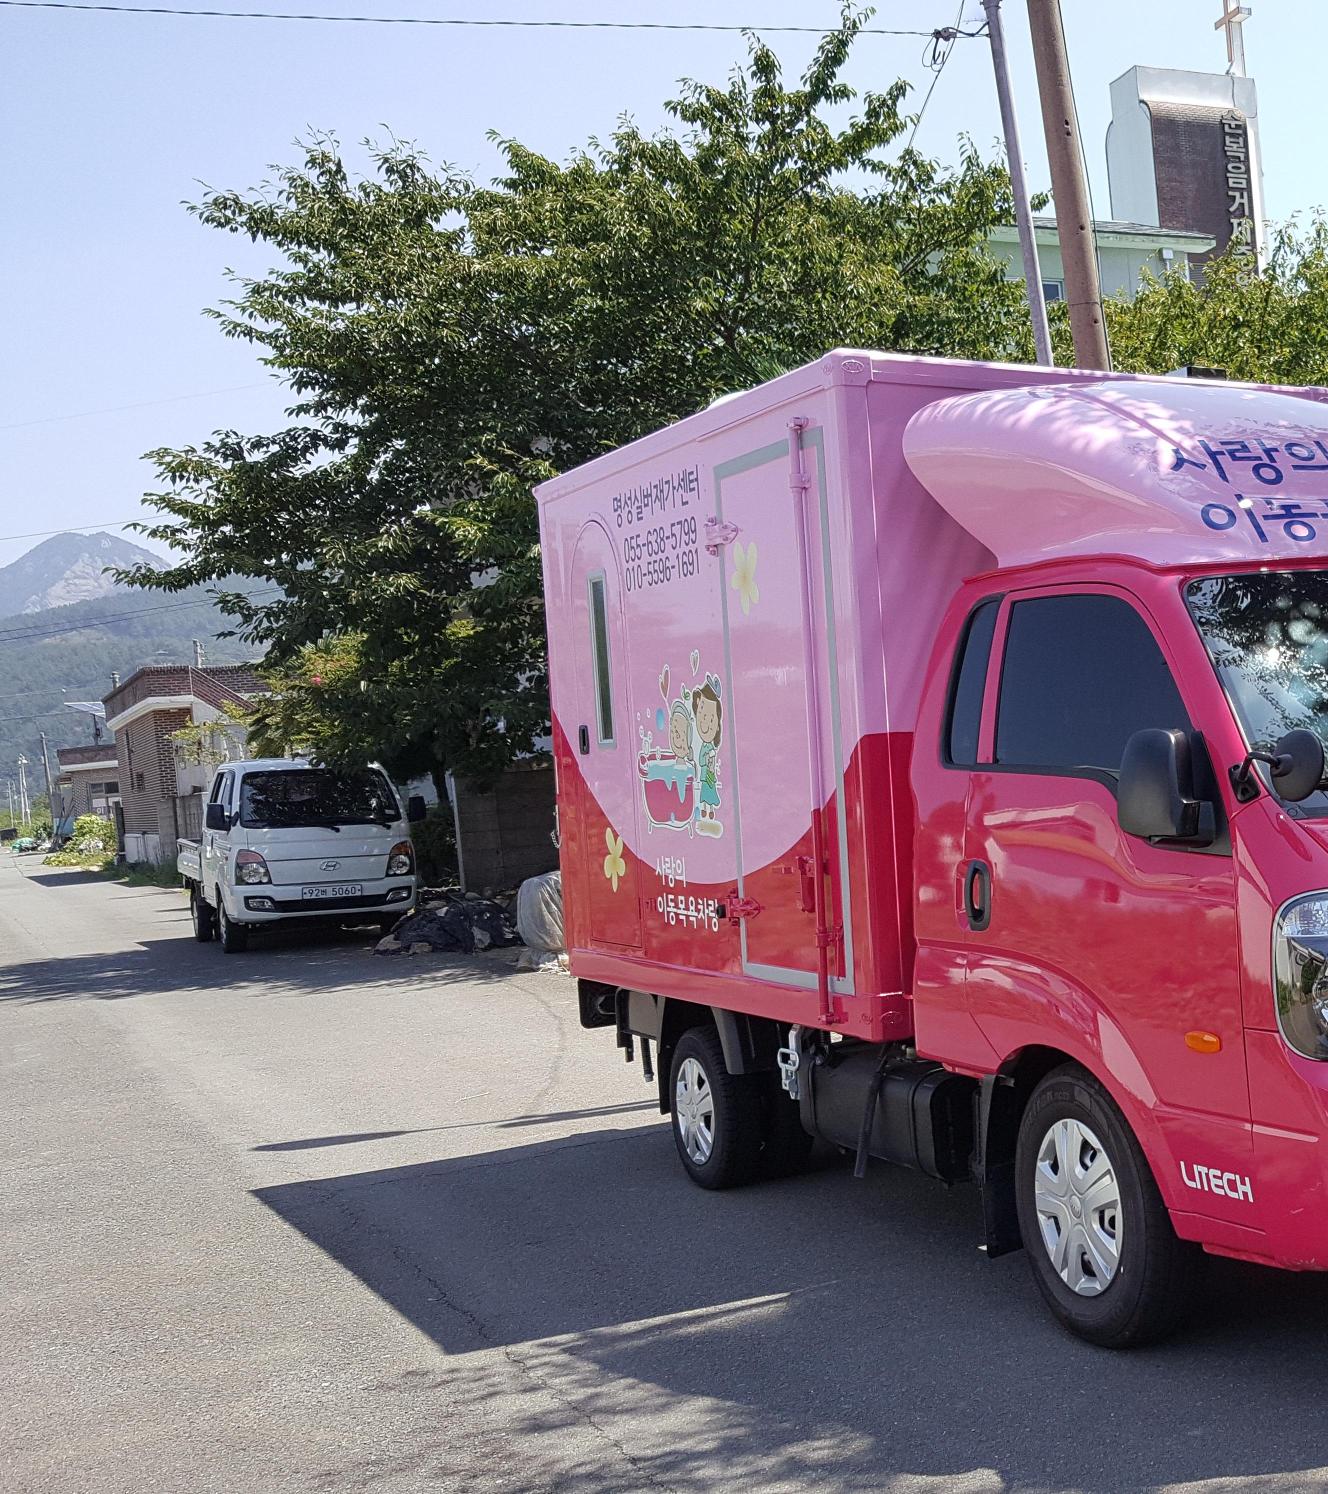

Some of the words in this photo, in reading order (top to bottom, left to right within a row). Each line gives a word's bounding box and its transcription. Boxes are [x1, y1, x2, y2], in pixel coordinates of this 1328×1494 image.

[612, 464, 700, 528] 명성실버재가센터
[623, 516, 697, 564] 055-638-5799
[625, 547, 700, 592] 010-5596-1691
[331, 886, 356, 896] 5060
[656, 855, 686, 887] 사랑의
[1180, 1160, 1254, 1203] LITECH
